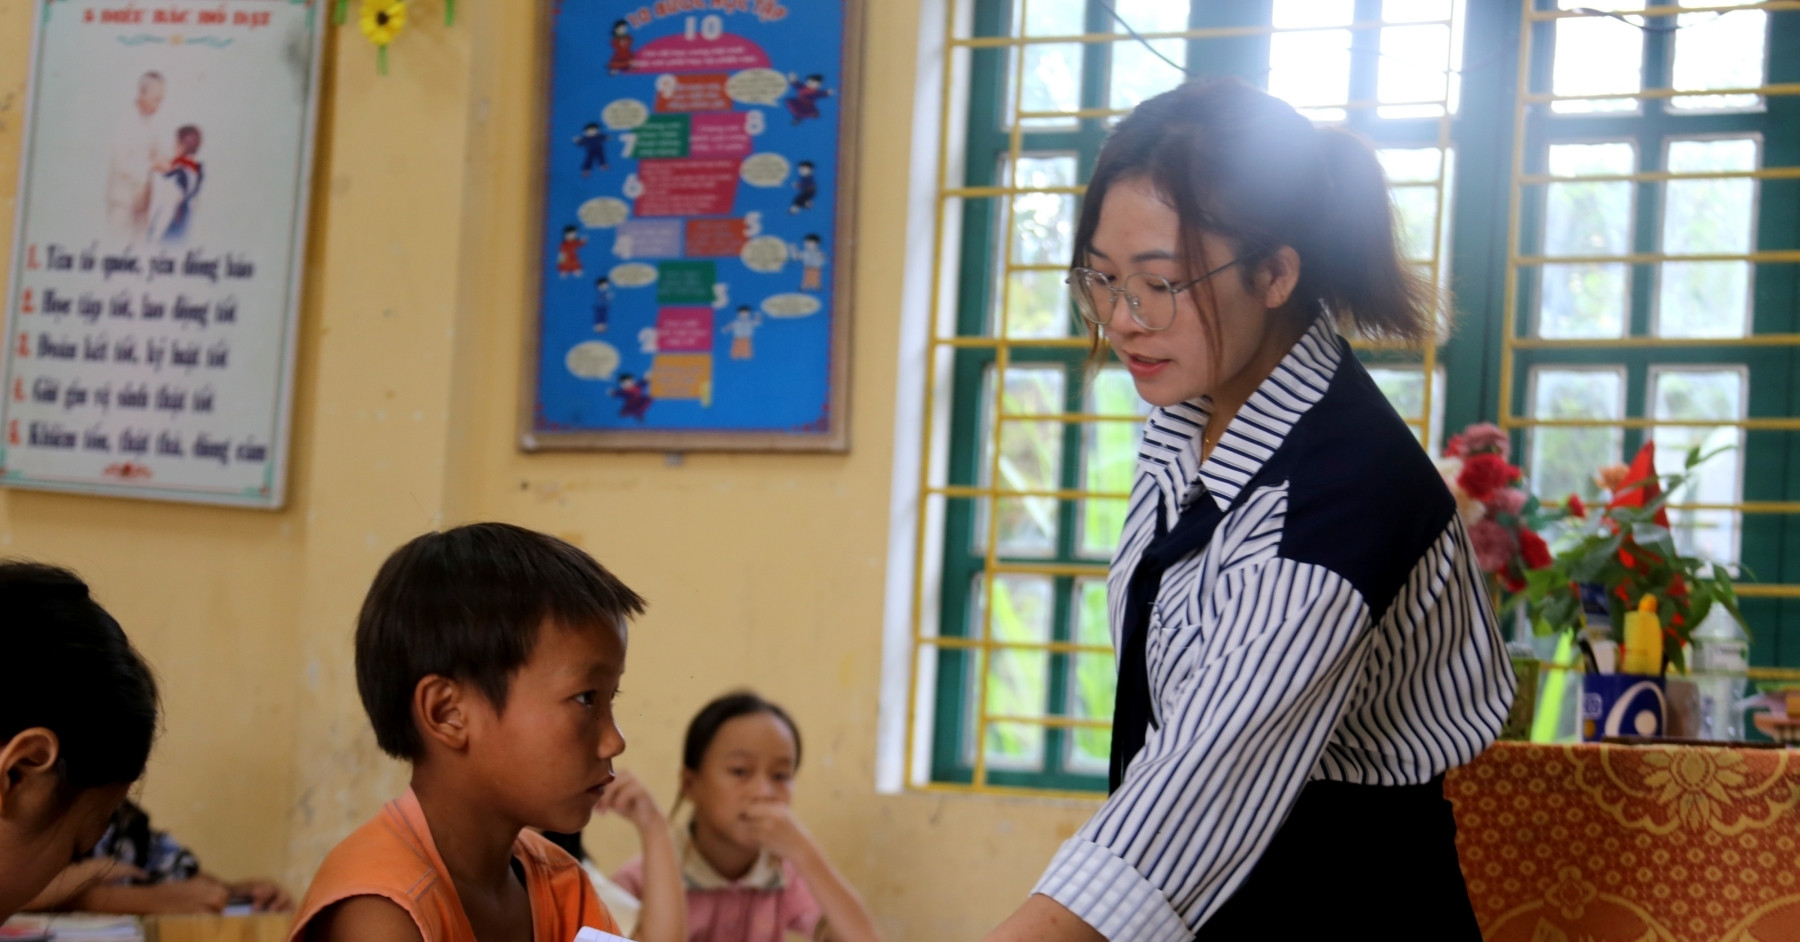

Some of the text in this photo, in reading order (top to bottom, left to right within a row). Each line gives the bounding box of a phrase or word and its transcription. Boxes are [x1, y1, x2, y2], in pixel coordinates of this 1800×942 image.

[684, 14, 723, 41] 10
[655, 73, 676, 98] 9
[743, 109, 765, 136] 8
[619, 133, 638, 158] 7
[622, 173, 644, 199] 6
[742, 211, 762, 237] 5
